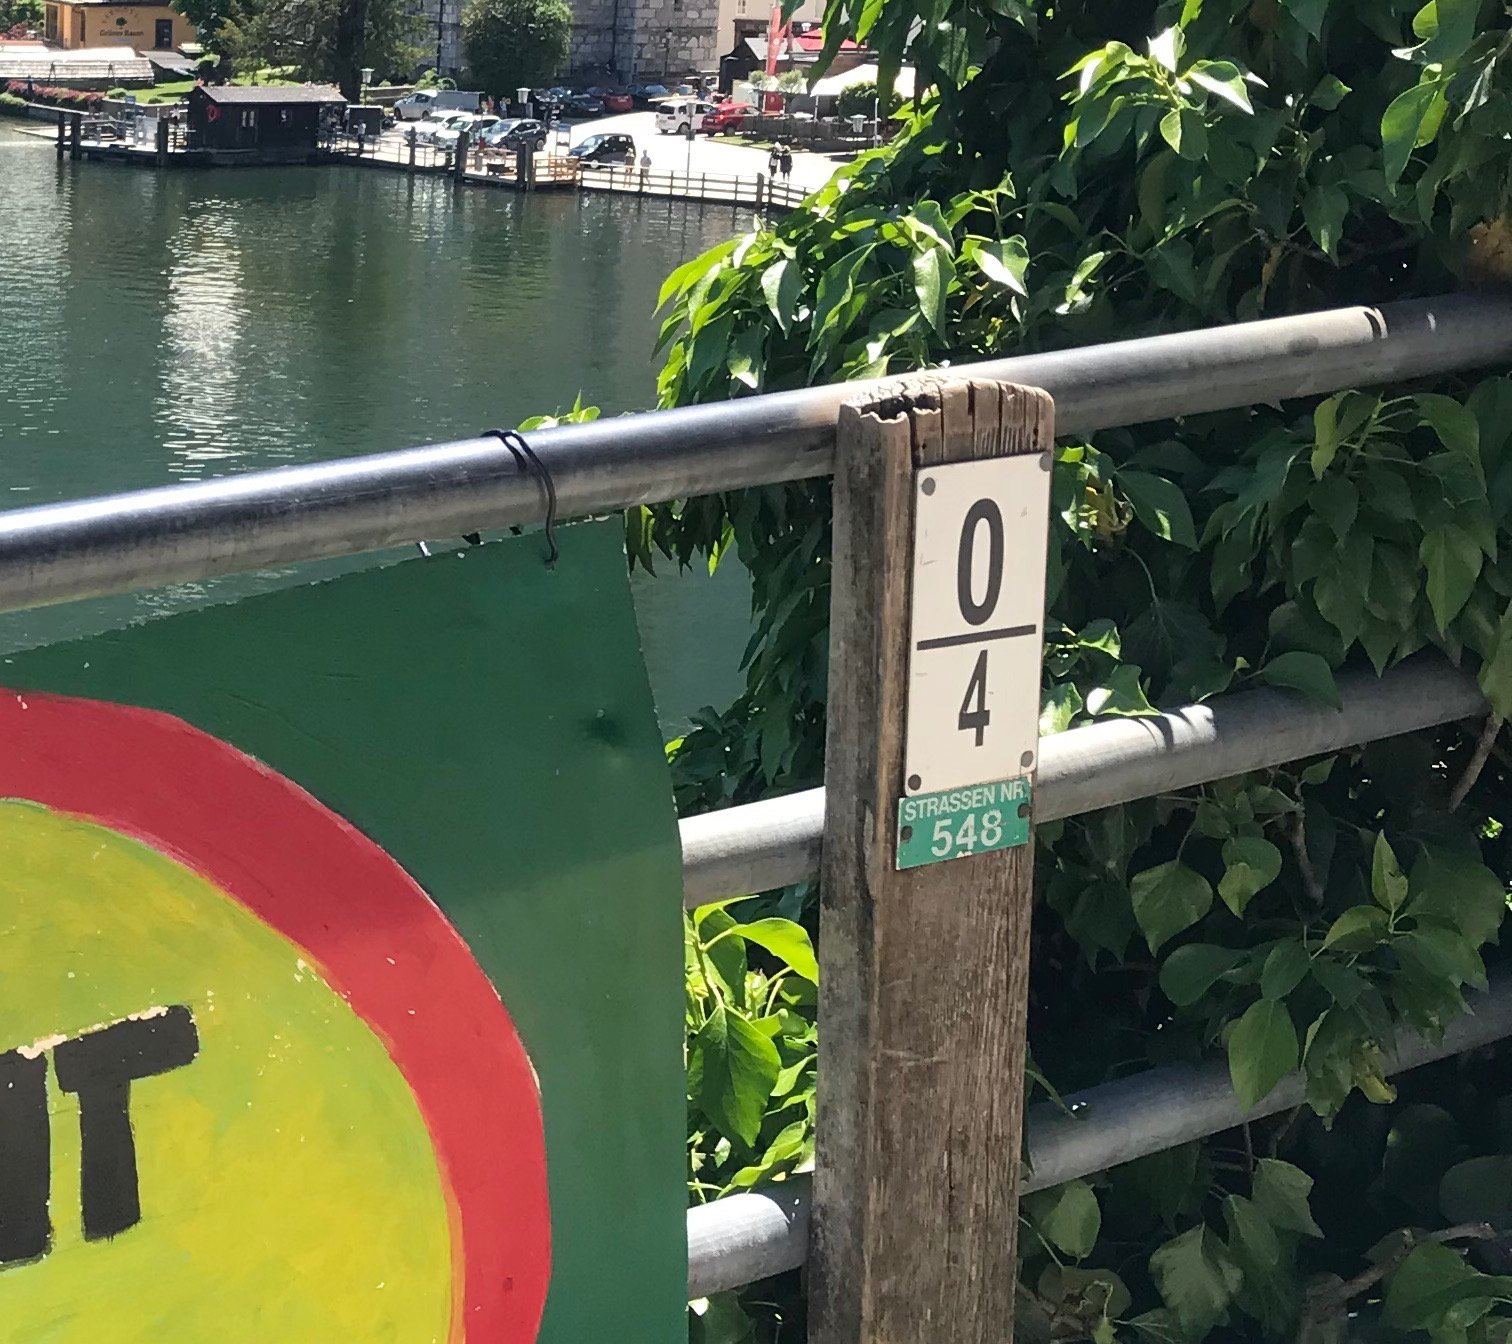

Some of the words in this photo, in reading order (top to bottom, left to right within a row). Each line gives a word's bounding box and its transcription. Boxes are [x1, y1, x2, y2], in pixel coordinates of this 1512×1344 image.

[957, 497, 1004, 626] 0
[958, 650, 990, 747] 4
[904, 784, 996, 822] STRASSEN
[931, 809, 1003, 857] 548
